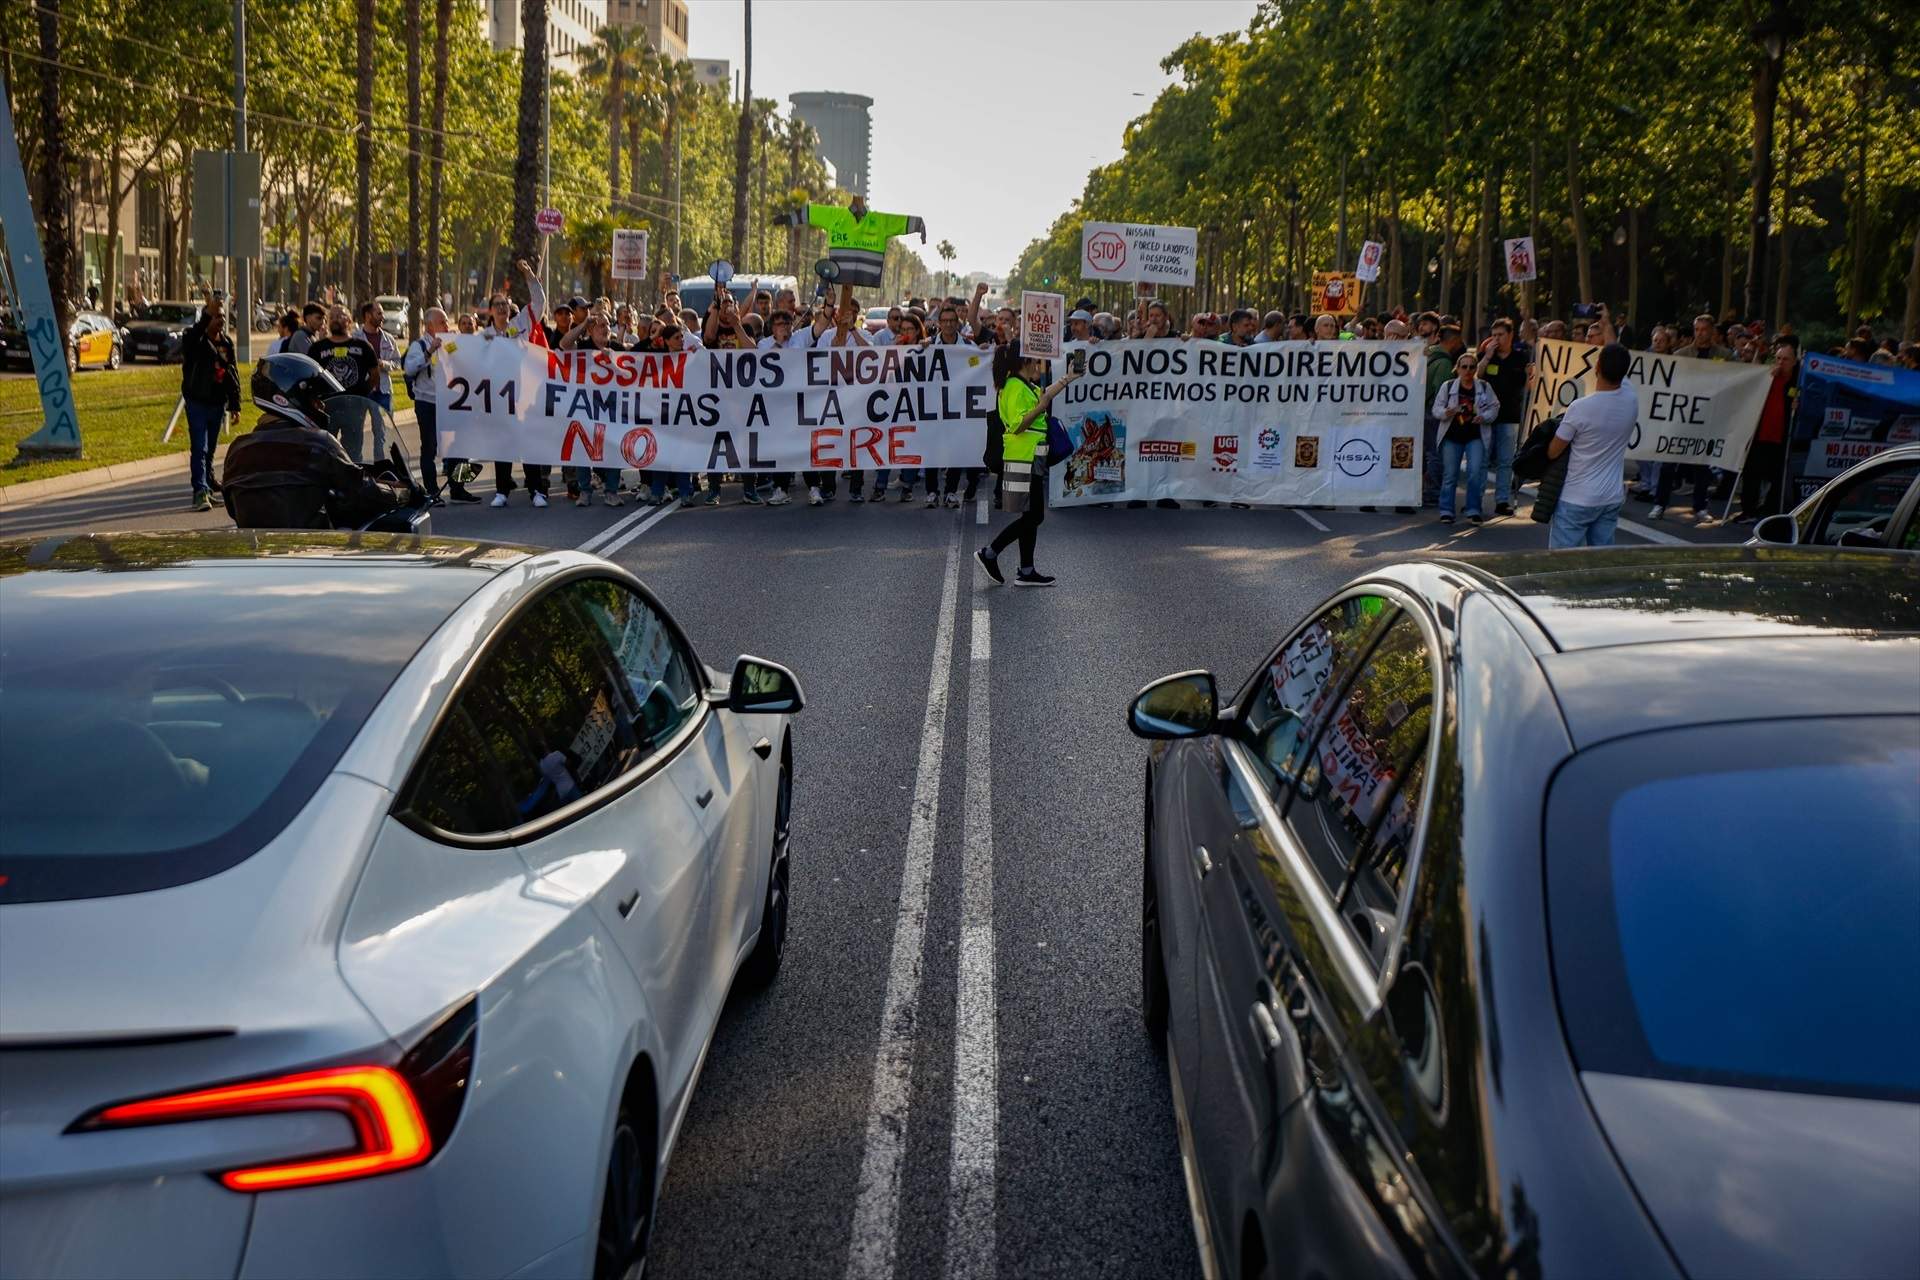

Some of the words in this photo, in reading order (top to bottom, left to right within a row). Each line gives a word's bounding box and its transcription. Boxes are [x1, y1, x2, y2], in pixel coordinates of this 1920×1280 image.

[1125, 227, 1156, 238] NISSAN
[1091, 241, 1123, 260] STOP
[1133, 240, 1160, 251] FORCED
[1028, 313, 1041, 323] NO
[1043, 314, 1056, 325] AL
[1031, 322, 1051, 334] ERE
[709, 351, 785, 390] NOS
[806, 347, 951, 387] ENGAÑA
[1121, 348, 1189, 376] NOS
[1199, 349, 1410, 378] RENDIREMOS
[1540, 343, 1677, 388] NISAN
[447, 376, 516, 416] 211
[745, 393, 771, 427] A
[796, 389, 845, 426] LA
[866, 385, 988, 424] CALLE
[1064, 381, 1217, 405] LUCHAREMOS
[1223, 383, 1271, 403] POR
[1276, 383, 1309, 403] UN
[1316, 383, 1410, 403] FUTURO
[1534, 376, 1578, 408] NO
[1649, 391, 1711, 425] ERE
[560, 419, 658, 469] NO
[707, 430, 777, 470] AL
[810, 424, 923, 469] ERE
[1218, 437, 1239, 449] UGT
[1656, 435, 1726, 459] DESPIDOS
[1333, 454, 1381, 462] NISSAN
